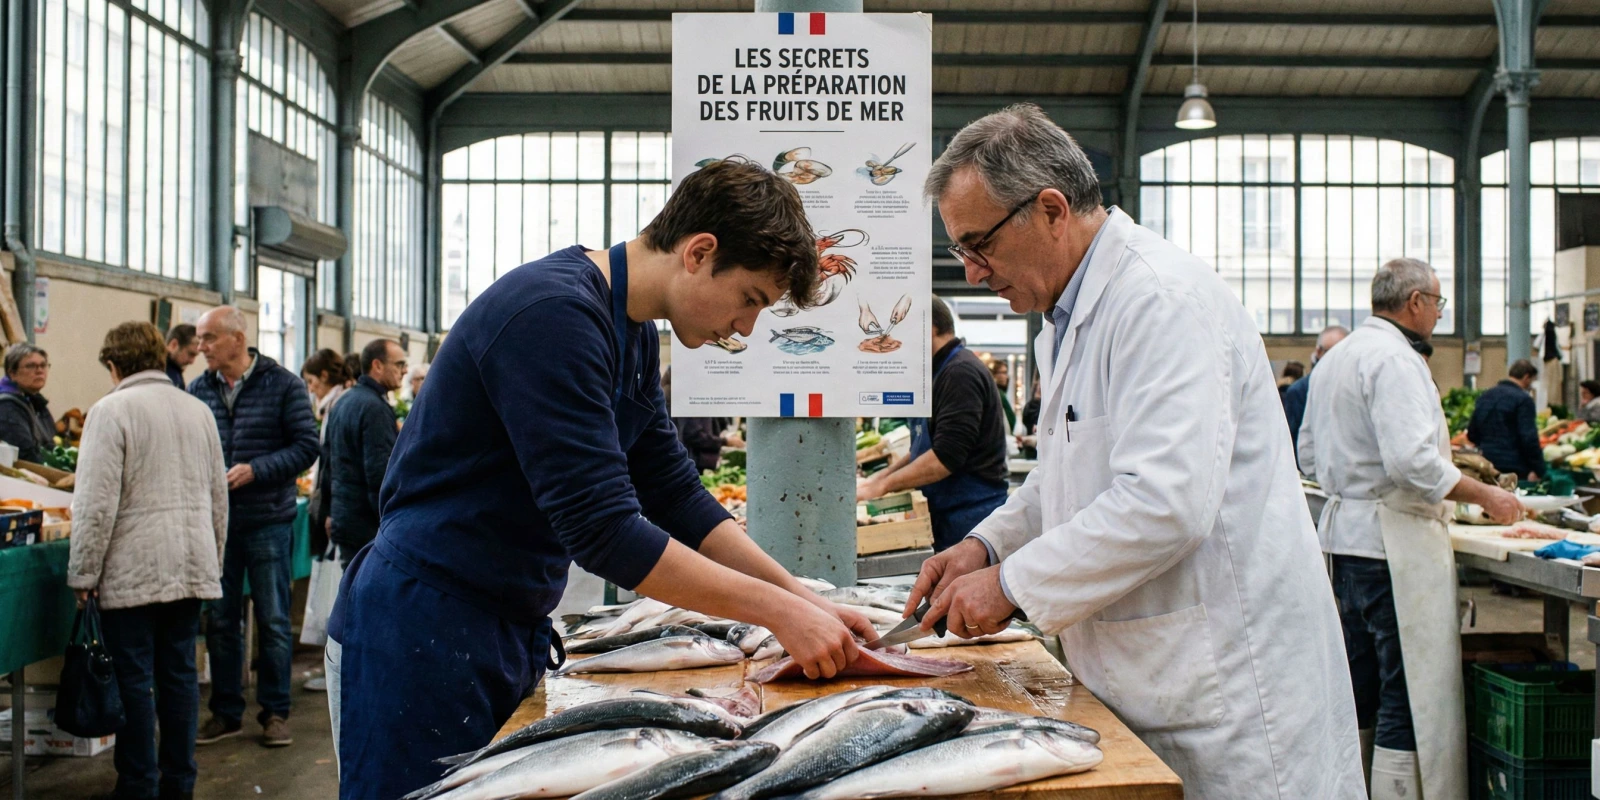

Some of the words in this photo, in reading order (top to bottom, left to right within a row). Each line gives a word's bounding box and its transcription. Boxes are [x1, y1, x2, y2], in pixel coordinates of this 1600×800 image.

[736, 48, 772, 68] LES
[778, 48, 869, 68] SECRETS
[698, 75, 724, 94] DE
[731, 75, 756, 94] LA
[764, 69, 906, 95] PRÉPARATION
[700, 101, 739, 121] DES
[747, 101, 819, 121] FRUITS
[827, 101, 853, 121] DE
[861, 101, 904, 121] MER
